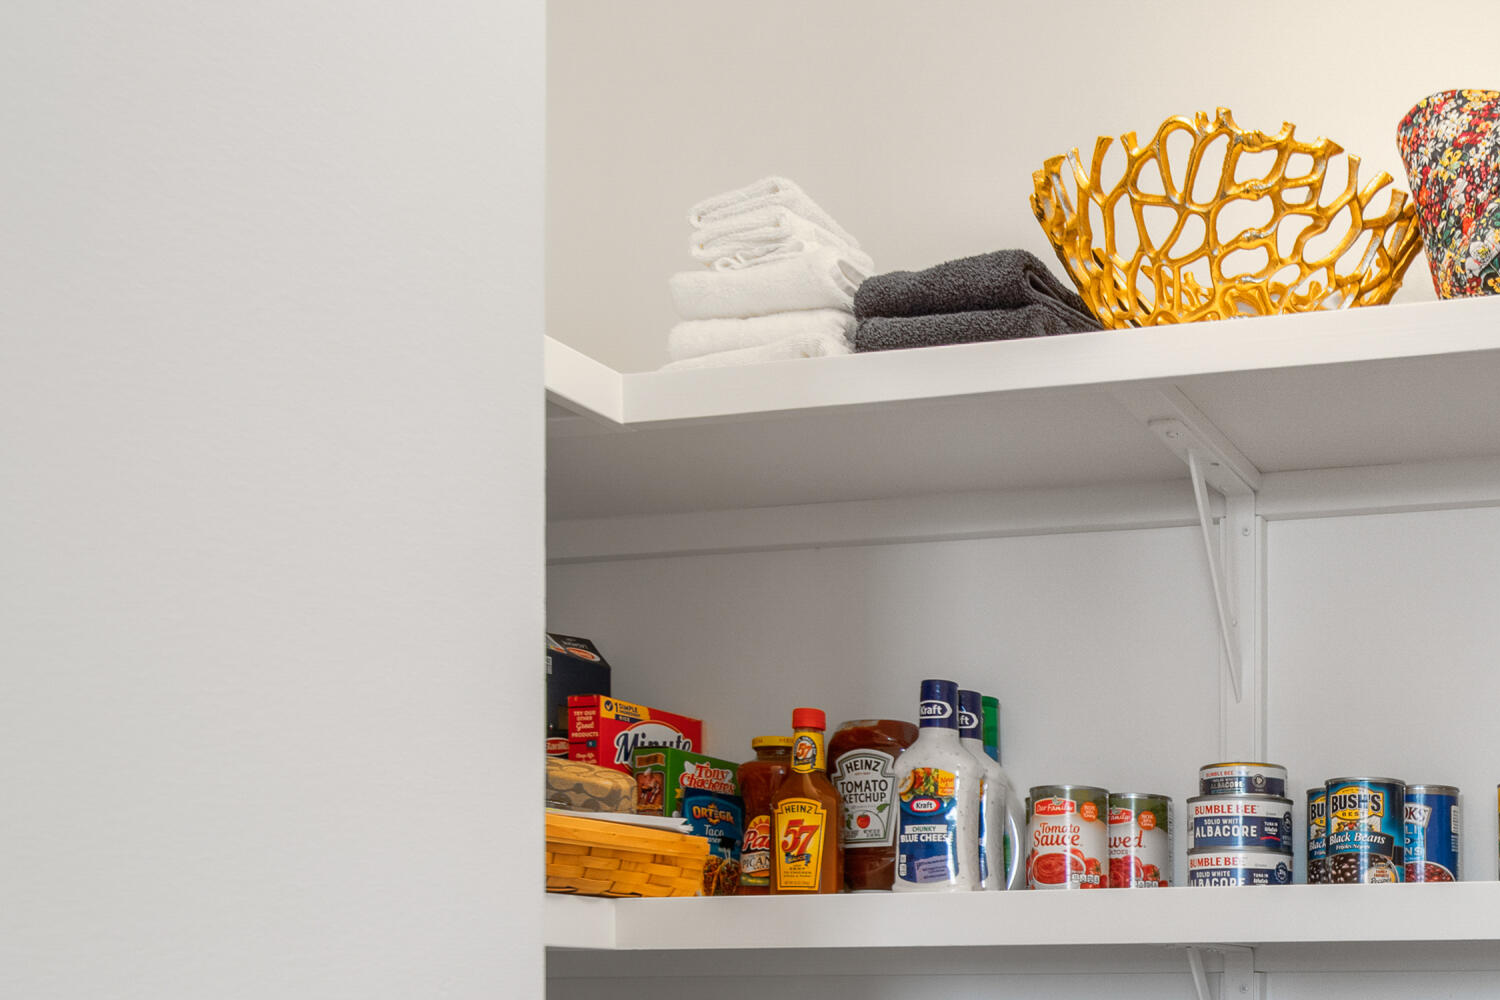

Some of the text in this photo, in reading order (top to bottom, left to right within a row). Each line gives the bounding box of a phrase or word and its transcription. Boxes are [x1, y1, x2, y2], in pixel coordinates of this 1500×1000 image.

[614, 733, 692, 763] Minute
[797, 742, 812, 760] 57
[845, 760, 882, 773] HEINZ
[840, 779, 889, 793] TOMATO
[784, 804, 814, 815] HEINZ
[916, 801, 933, 810] Kraft
[1331, 794, 1381, 812] BUSH'S
[692, 804, 736, 826] ORTEGA
[1194, 805, 1232, 815] BUMBLE
[704, 824, 724, 837] Taco
[1040, 822, 1080, 834] Tomato
[1196, 825, 1257, 838] ALBACORE
[781, 819, 820, 856] 57
[900, 834, 918, 843] BLUE
[1034, 830, 1080, 847] Sauce
[1330, 832, 1386, 845] Black Beans
[1190, 857, 1222, 868] BUMBLE
